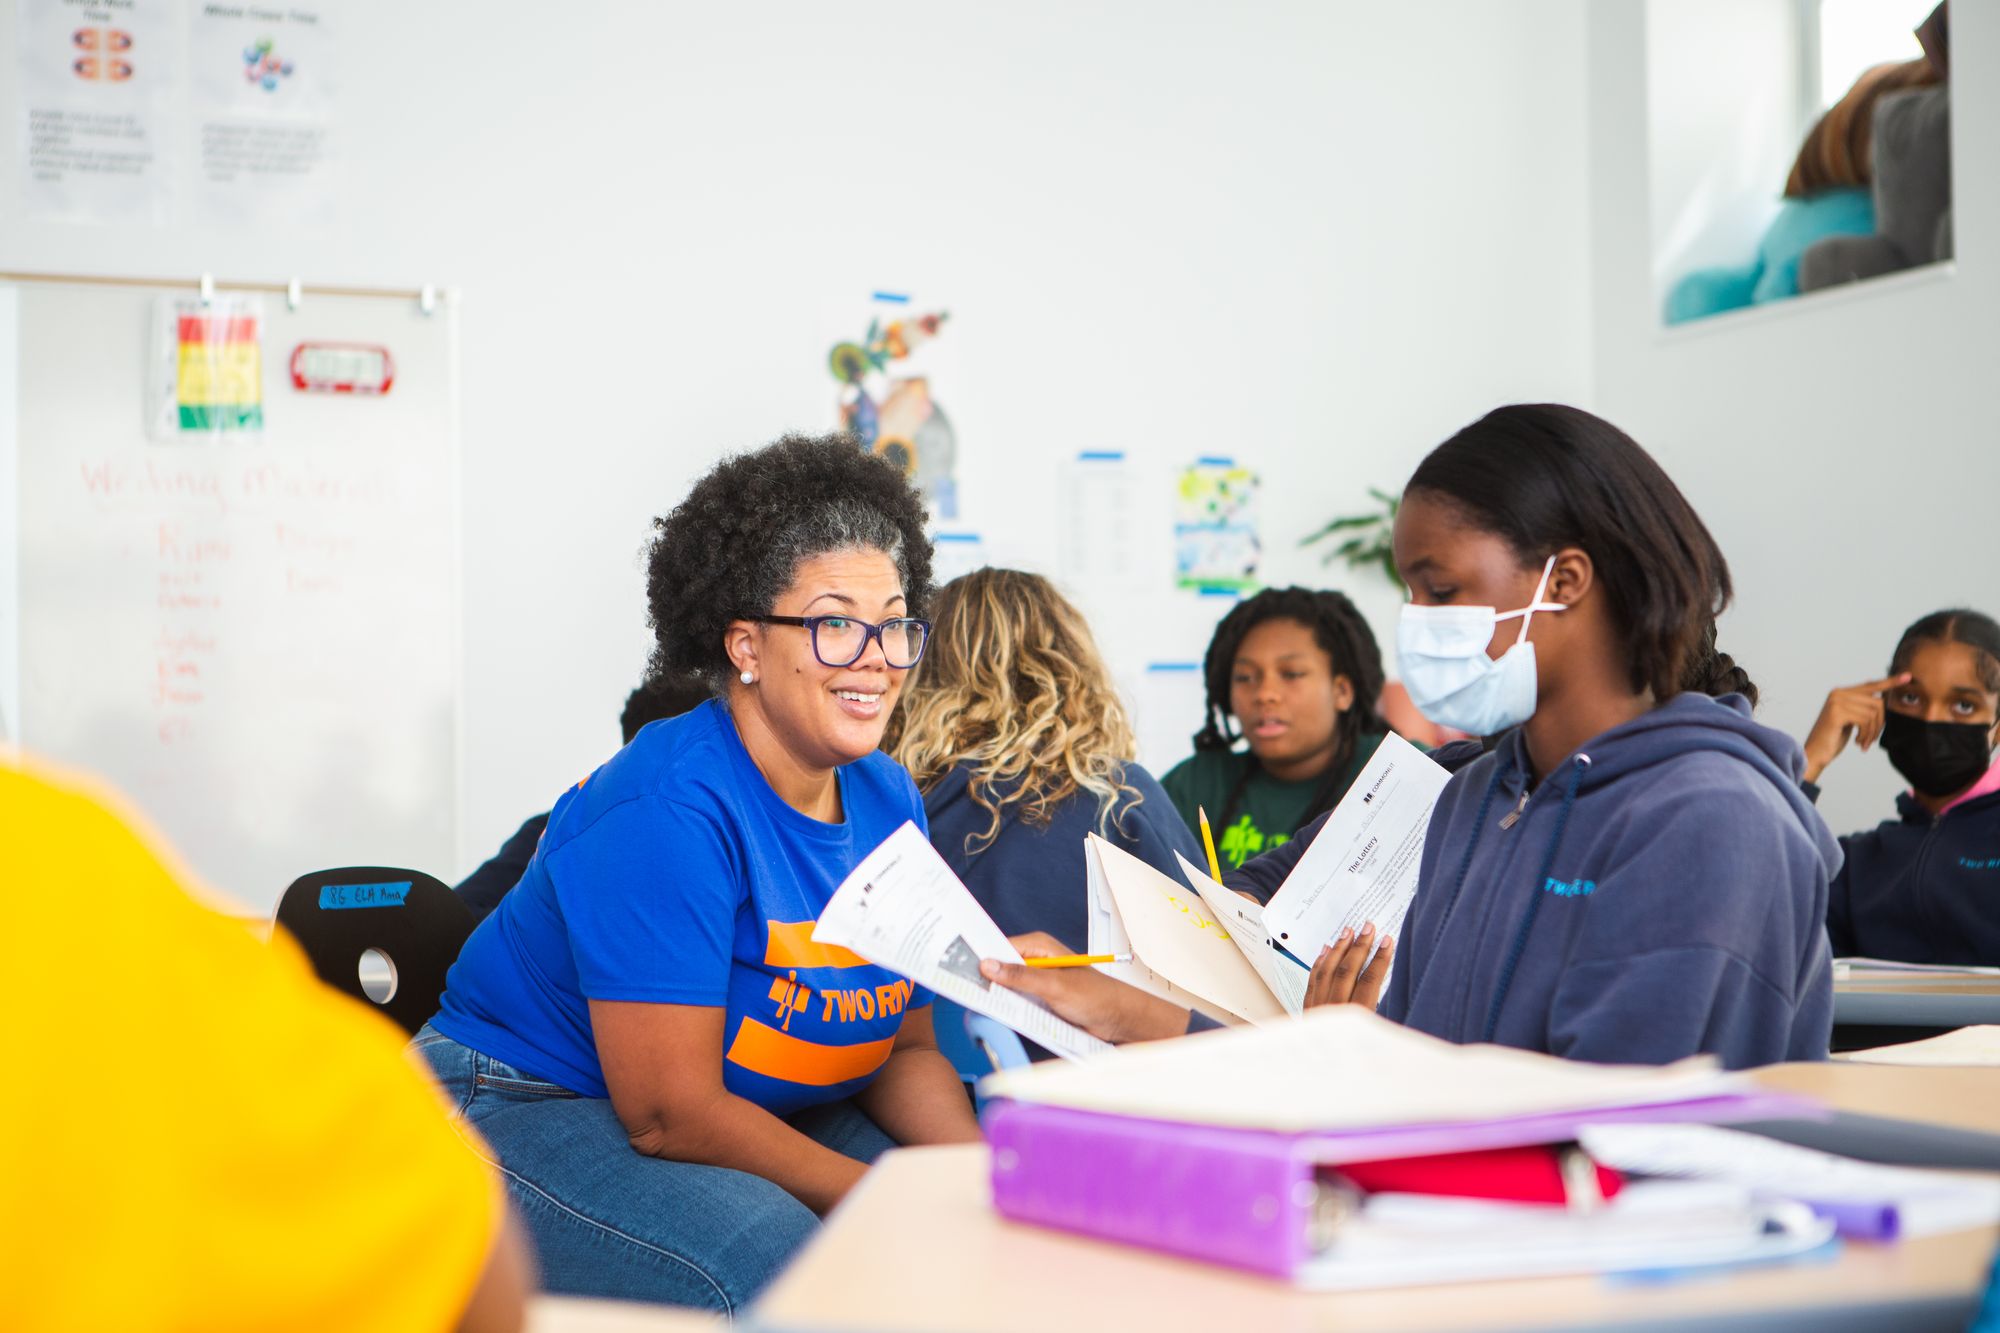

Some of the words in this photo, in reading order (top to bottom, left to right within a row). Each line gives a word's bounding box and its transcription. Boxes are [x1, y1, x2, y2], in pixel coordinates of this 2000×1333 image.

[1372, 763, 1395, 792] COMMONLIT
[1349, 859, 1361, 873] The
[1358, 836, 1379, 861] Lottery
[820, 988, 876, 1023] TWO
